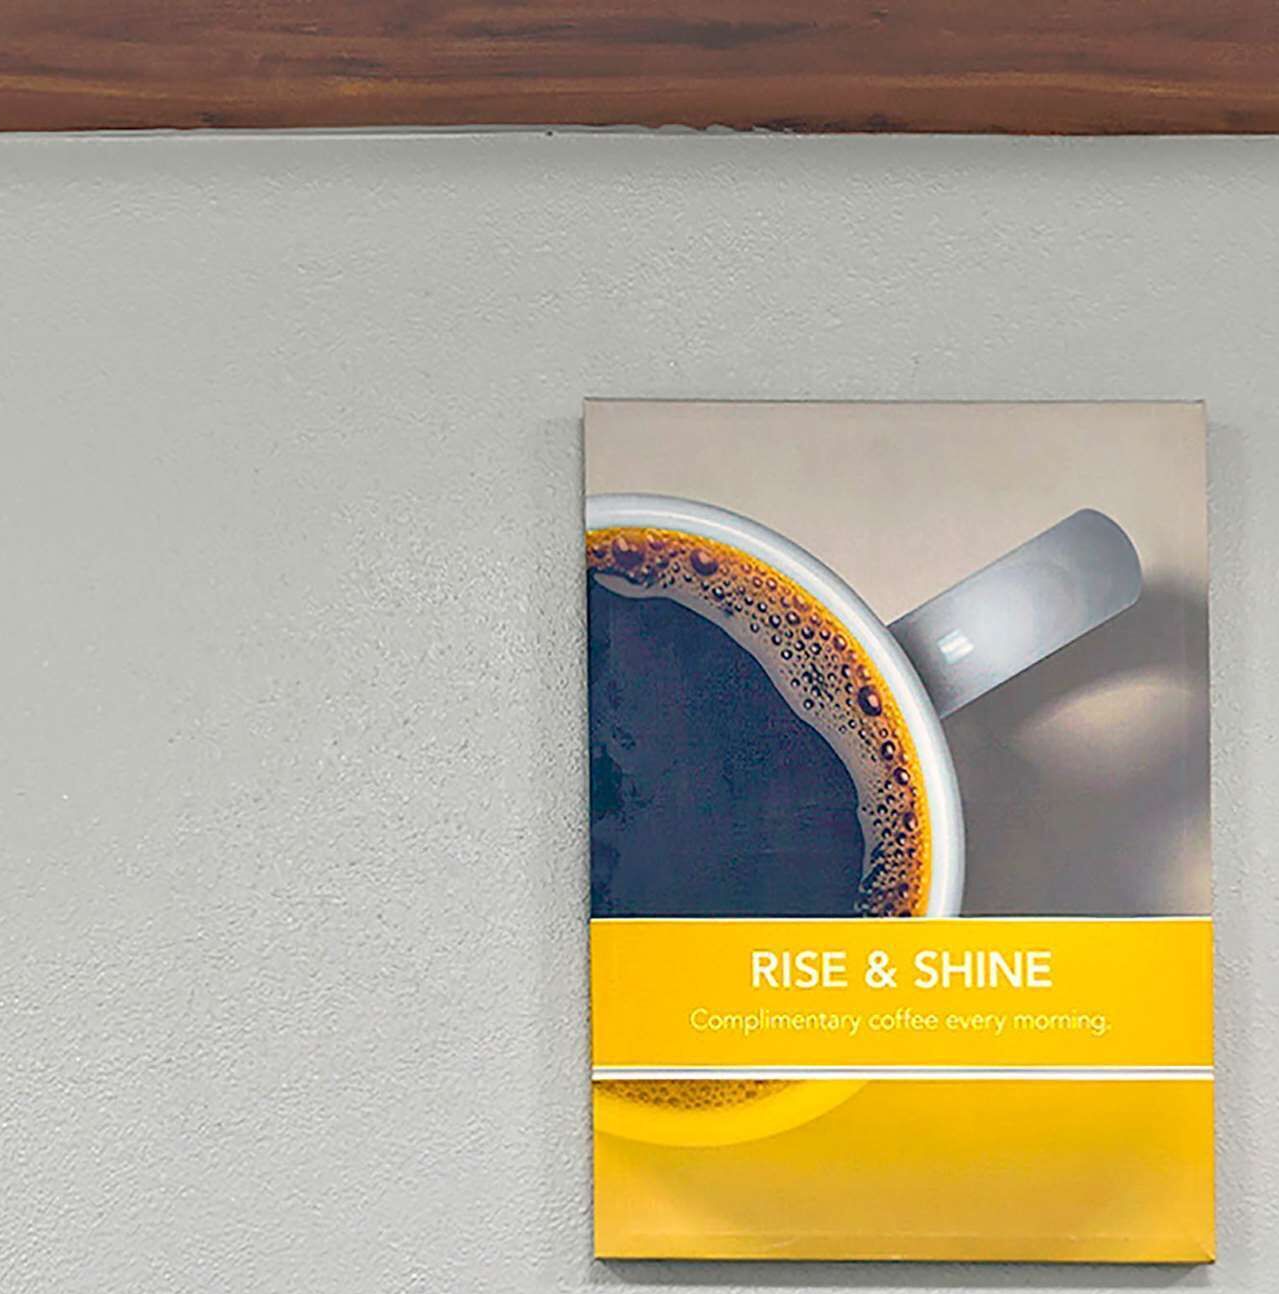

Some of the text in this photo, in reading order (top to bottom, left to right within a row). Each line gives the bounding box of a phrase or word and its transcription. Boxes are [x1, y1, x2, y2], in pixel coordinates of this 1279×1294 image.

[751, 950, 1052, 988] RISE & SHINE
[689, 1007, 1111, 1037] Complimentary coffee every morning.
